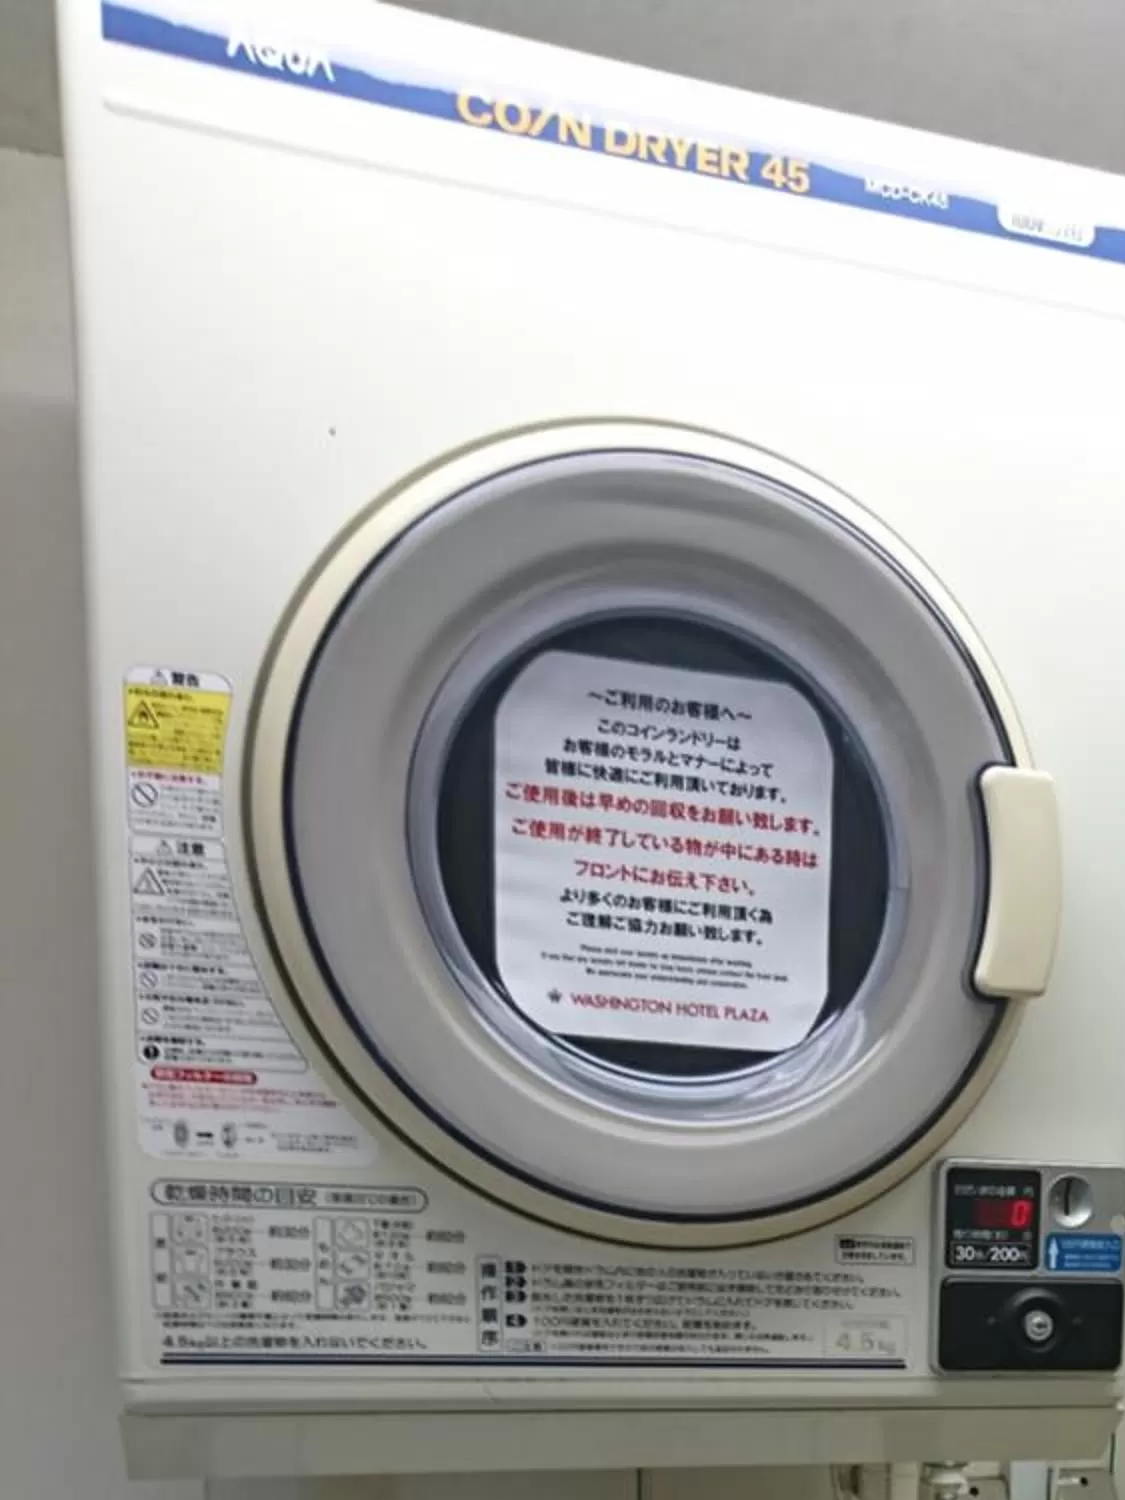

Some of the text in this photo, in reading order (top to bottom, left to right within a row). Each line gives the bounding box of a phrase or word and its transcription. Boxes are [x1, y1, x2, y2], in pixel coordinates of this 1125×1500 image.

[604, 124, 750, 181] DRYER
[761, 155, 810, 194] 45
[596, 717, 741, 752] このコインランドリーは
[562, 737, 775, 779] お客様のモラルとマナーによって
[573, 859, 756, 896] フロントにお伝え下さい。
[570, 991, 770, 1024] WASHINGTON HOTEL PLAZA
